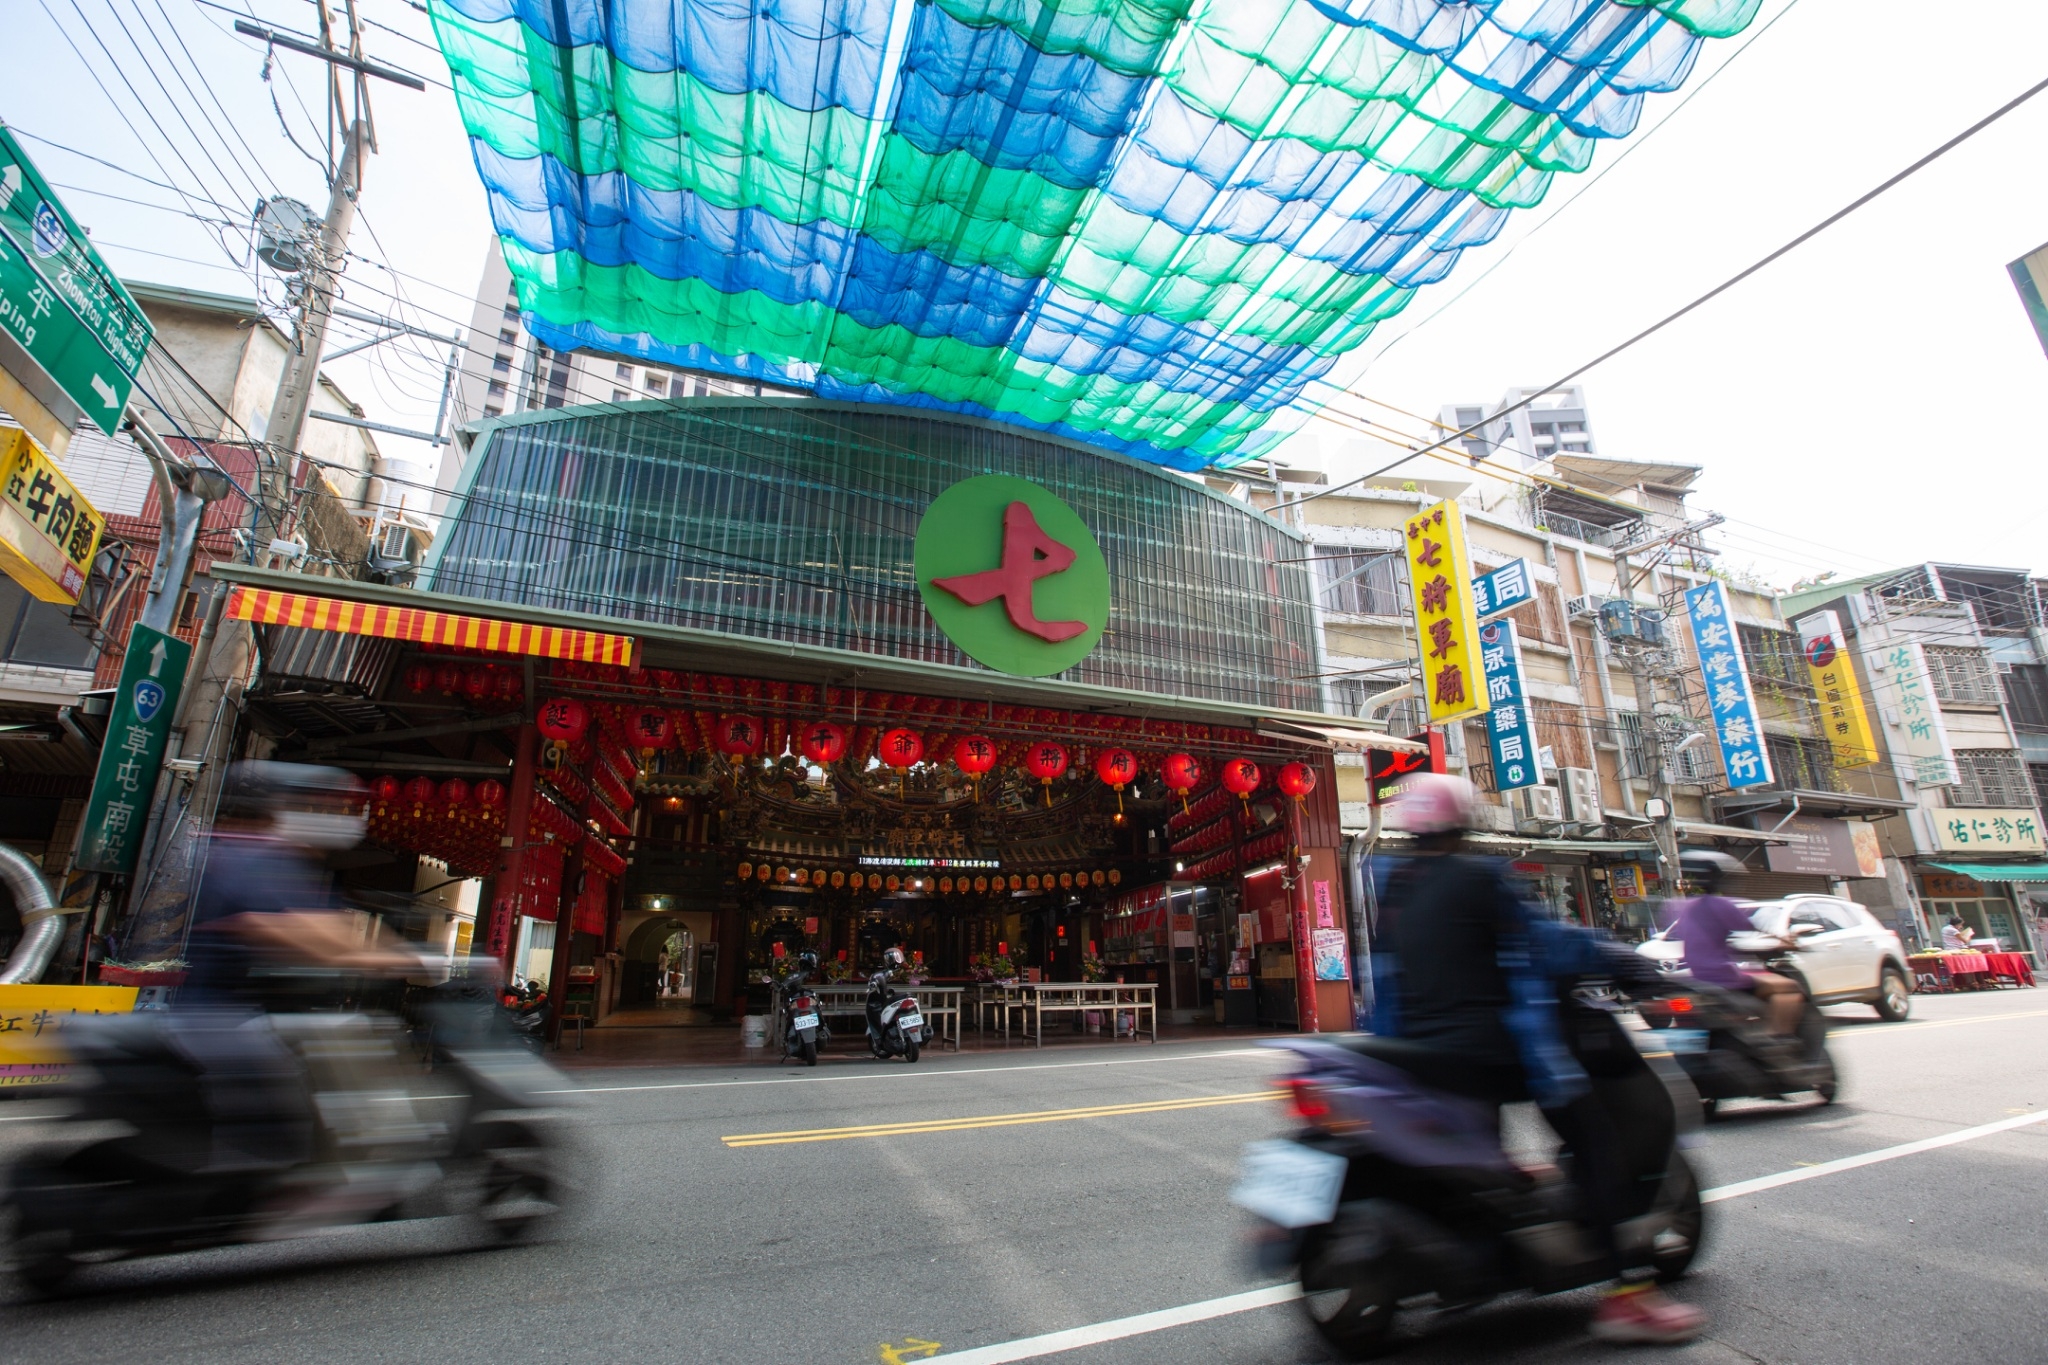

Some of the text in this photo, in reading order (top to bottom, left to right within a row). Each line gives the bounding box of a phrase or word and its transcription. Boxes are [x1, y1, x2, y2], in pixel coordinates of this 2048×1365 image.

[57, 265, 138, 371] Zhongtou Highway
[8, 449, 33, 502] 小江
[930, 501, 1089, 644] 七
[1416, 538, 1466, 706] 七將軍廟
[137, 688, 158, 708] 63
[1484, 646, 1524, 764] 永欣藥局
[1889, 647, 1931, 740] 佑仁診所
[810, 728, 834, 752] 千
[966, 740, 990, 760] 軍
[1109, 753, 1131, 772] 府
[1184, 758, 1200, 779] 七
[1948, 816, 2037, 844] 佑仁診所
